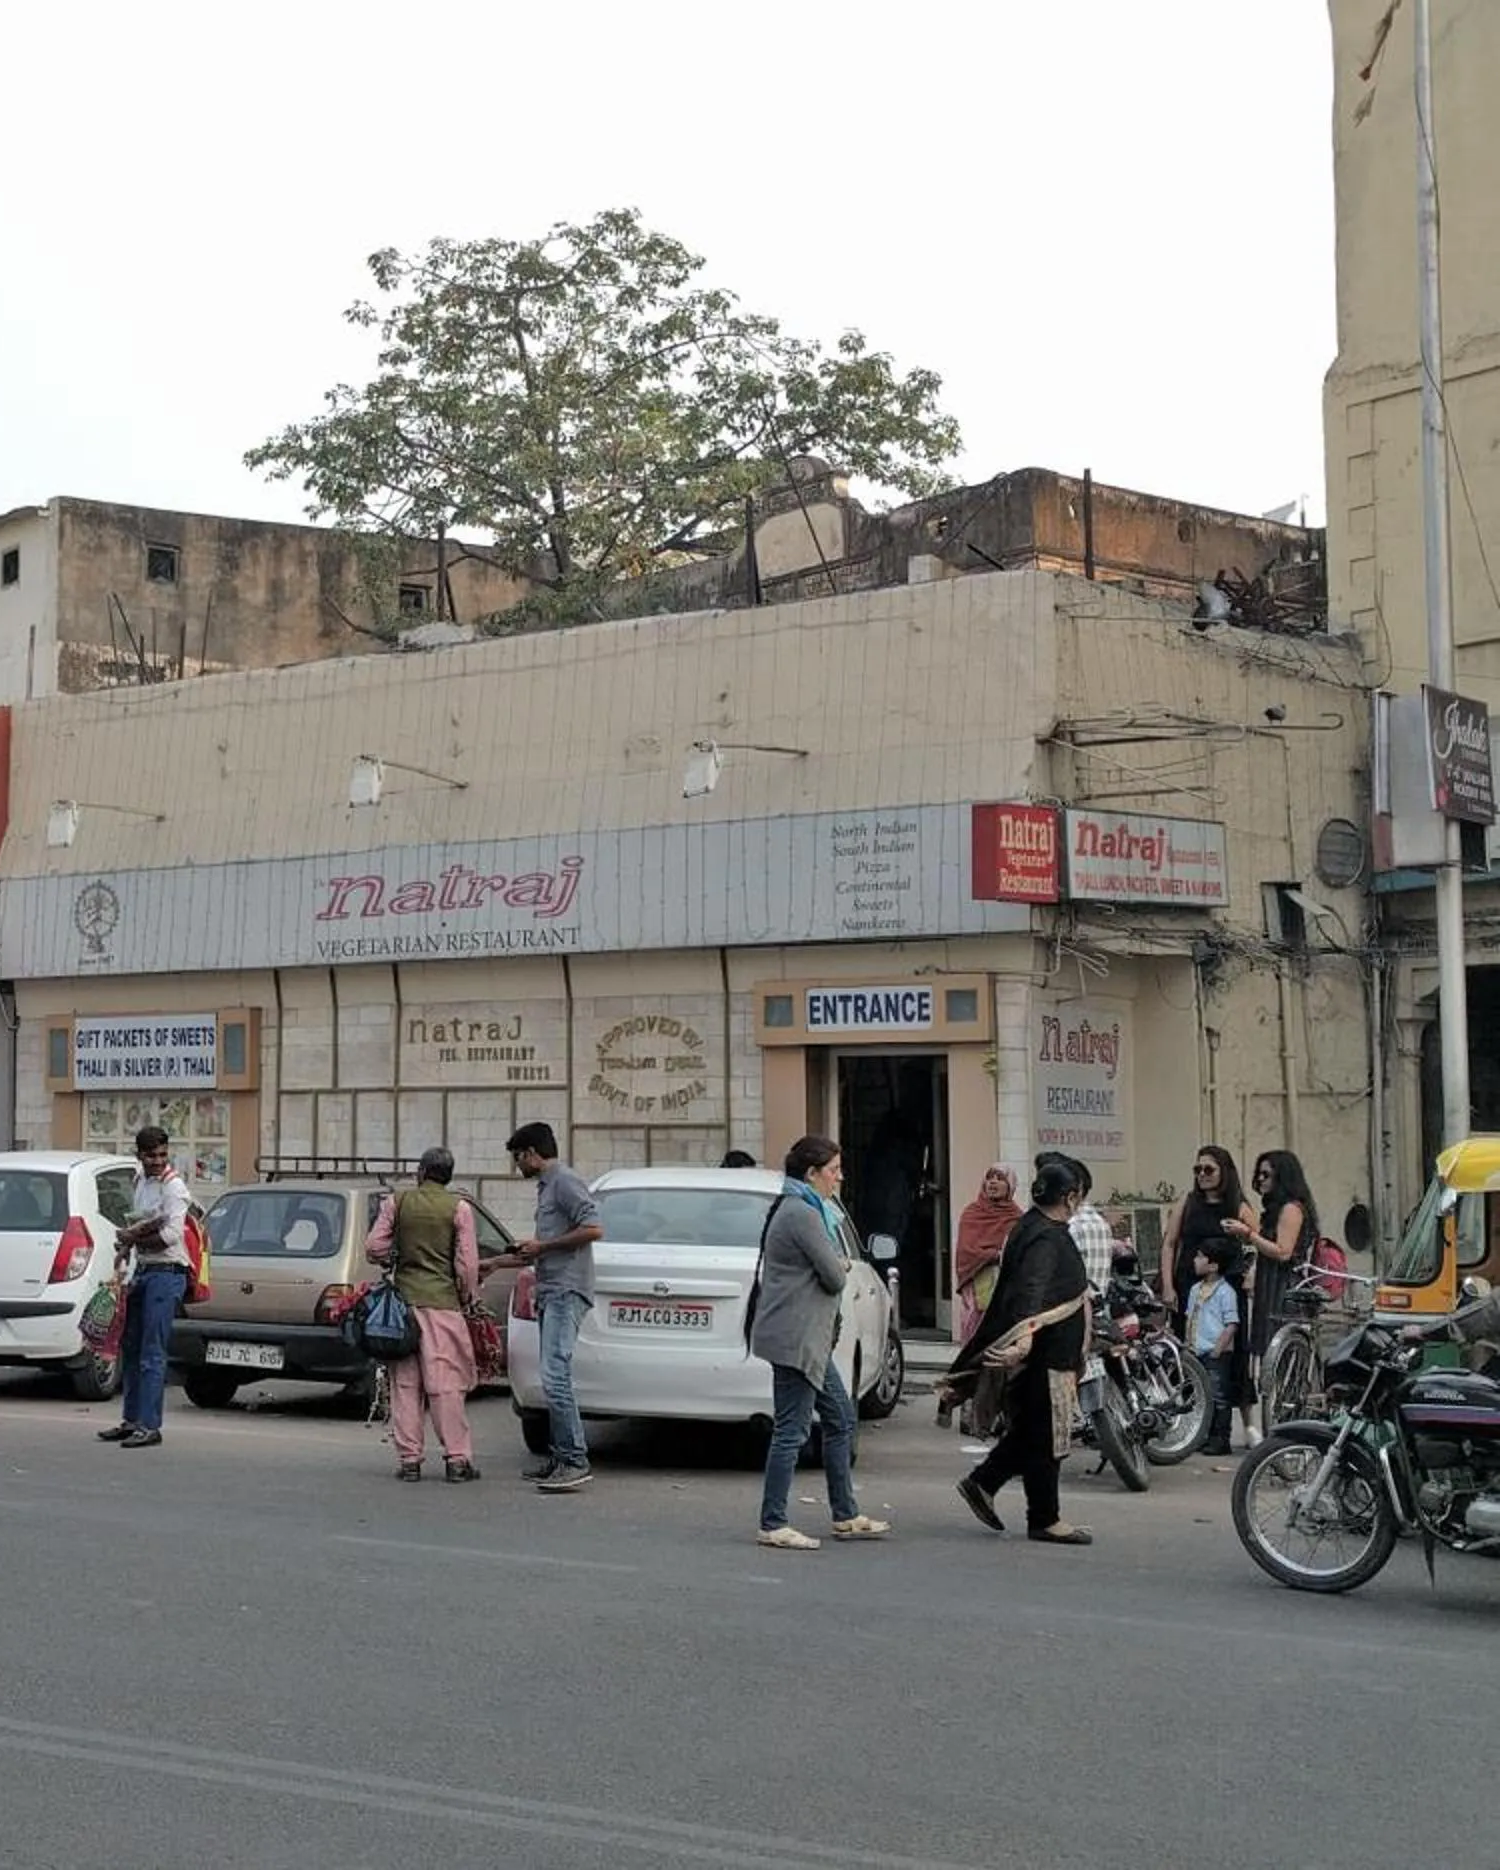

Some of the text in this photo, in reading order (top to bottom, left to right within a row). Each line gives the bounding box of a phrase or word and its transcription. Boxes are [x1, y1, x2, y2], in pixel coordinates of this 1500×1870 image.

[317, 927, 579, 959] VEGETARIAN RESTAURANT
[809, 992, 930, 1024] ENTRANCE
[76, 1027, 214, 1048] GIFT PACKETS OF SWEETS
[596, 1015, 704, 1056] APPROVED BY
[76, 1059, 106, 1077] THALI
[110, 1059, 121, 1076] IN
[124, 1058, 161, 1076] SILVER
[183, 1057, 214, 1076] THALI
[634, 1096, 656, 1112] OF
[661, 1080, 706, 1110] INDIA
[1047, 1087, 1115, 1112] RESTAURANT
